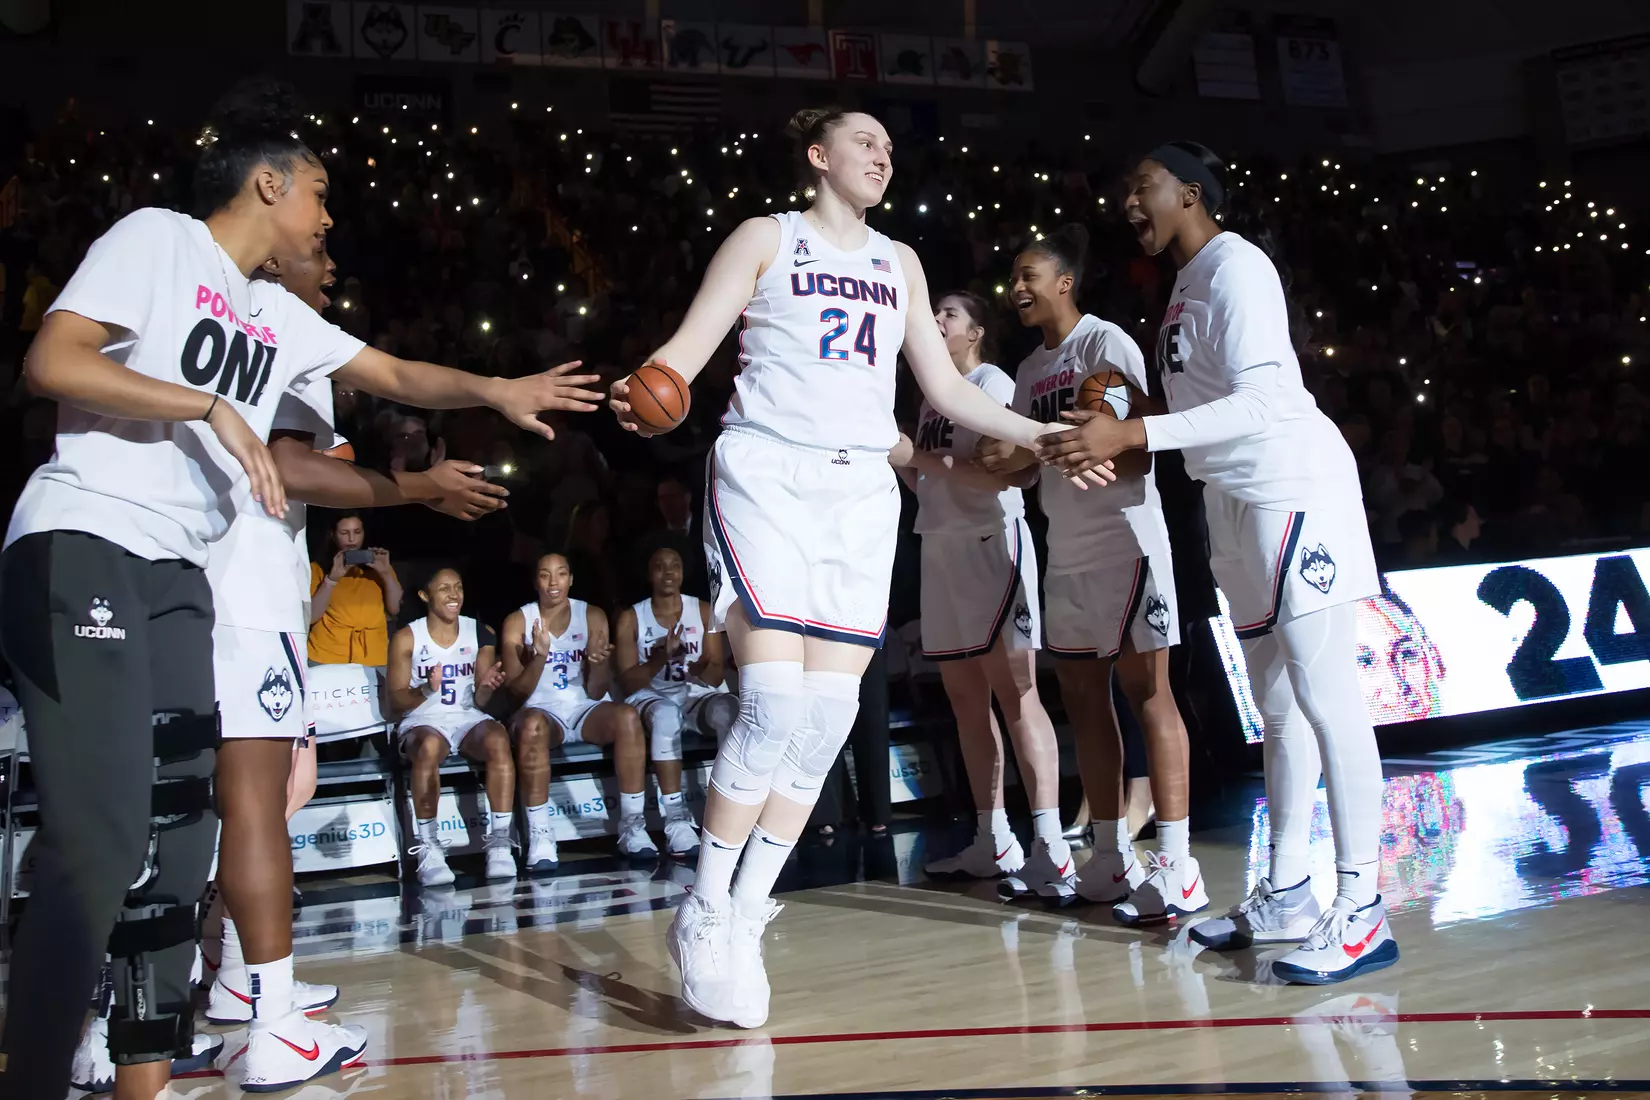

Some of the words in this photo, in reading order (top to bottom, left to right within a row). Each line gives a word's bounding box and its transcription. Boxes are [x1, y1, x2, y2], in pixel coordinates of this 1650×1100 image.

[363, 92, 442, 110] UCONN
[790, 272, 898, 311] UCONN
[819, 307, 877, 367] 24
[74, 625, 126, 640] UCONN
[1476, 554, 1650, 702] 24
[418, 662, 475, 679] UONN
[553, 664, 568, 690] 3
[664, 660, 685, 681] 13
[313, 697, 371, 710] GALAX
[441, 680, 456, 705] 5
[291, 822, 386, 850] genius3D
